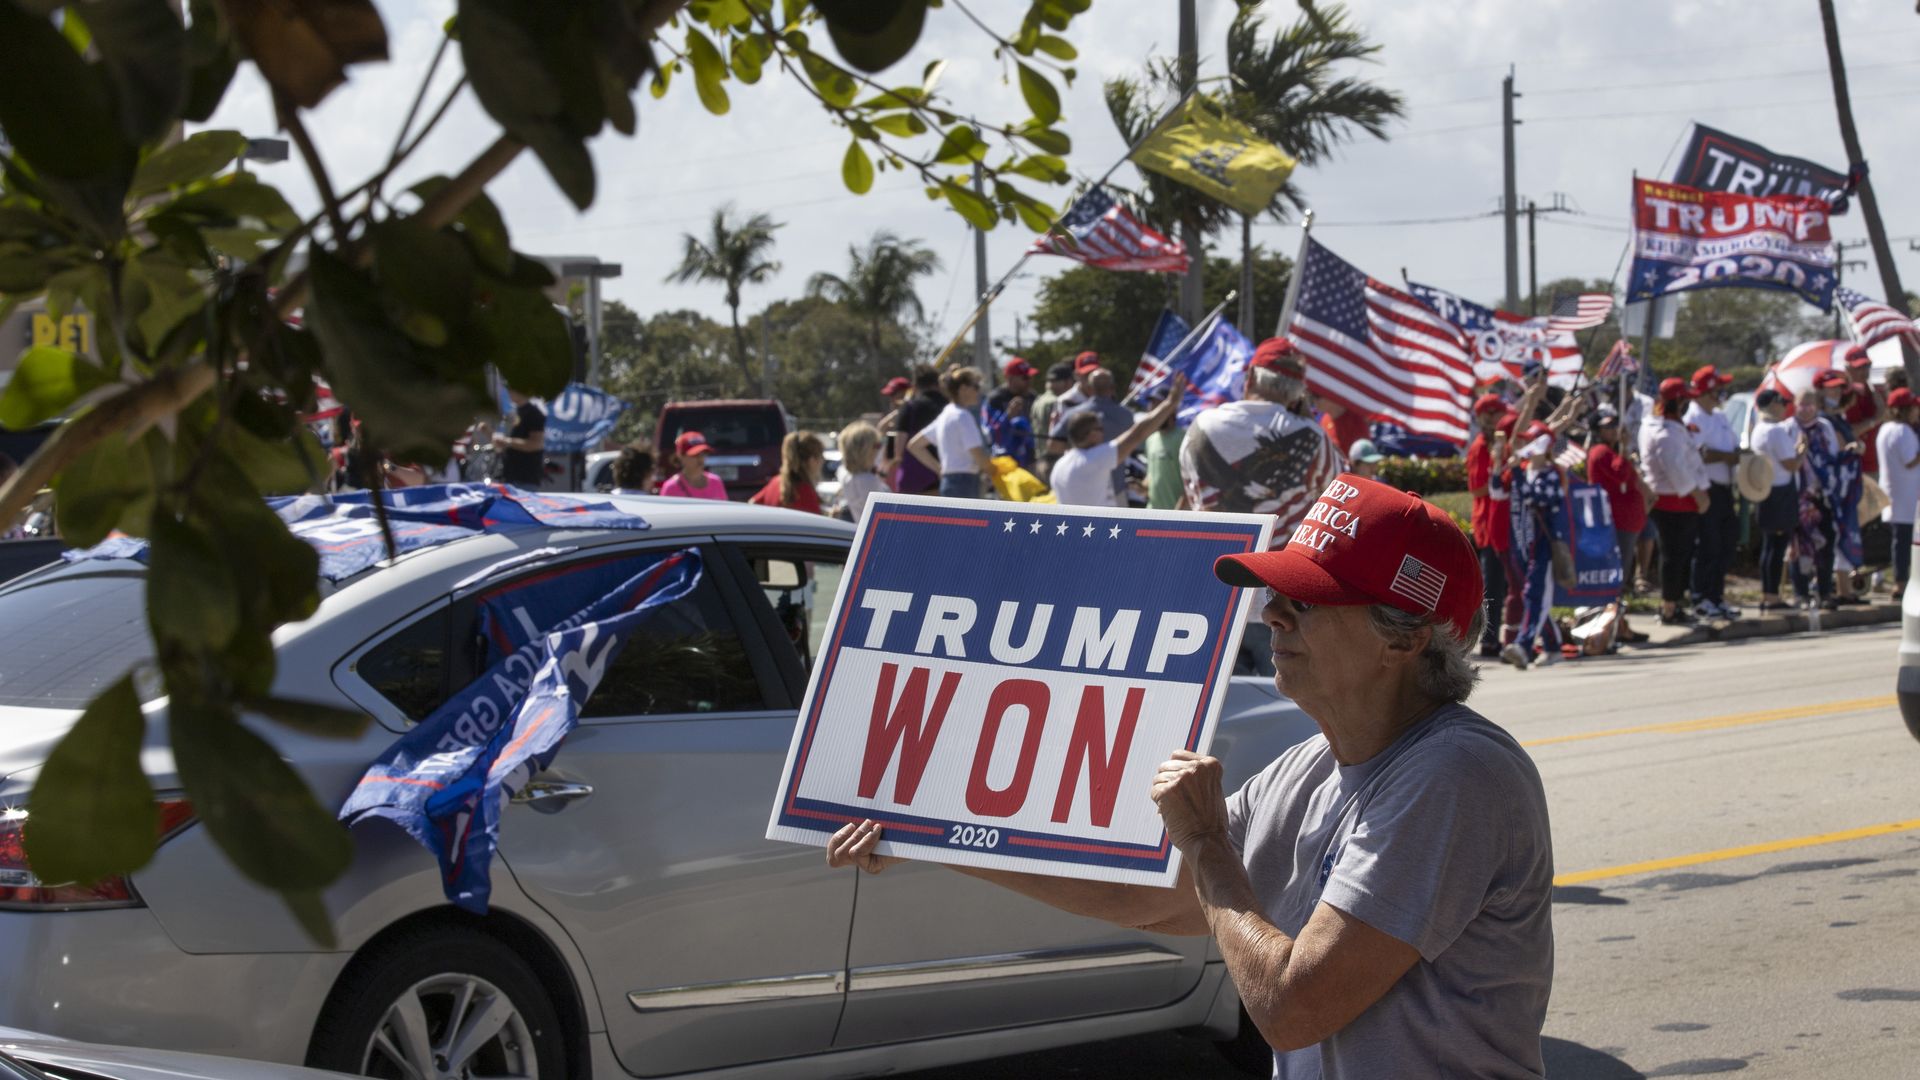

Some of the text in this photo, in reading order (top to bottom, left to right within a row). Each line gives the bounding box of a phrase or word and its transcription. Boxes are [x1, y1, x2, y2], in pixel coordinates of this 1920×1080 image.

[1645, 197, 1824, 241] TRUMP
[1664, 256, 1807, 291] 2020
[861, 588, 1209, 673] TRUMP
[857, 662, 1146, 828] WON
[948, 824, 1000, 849] 2020
